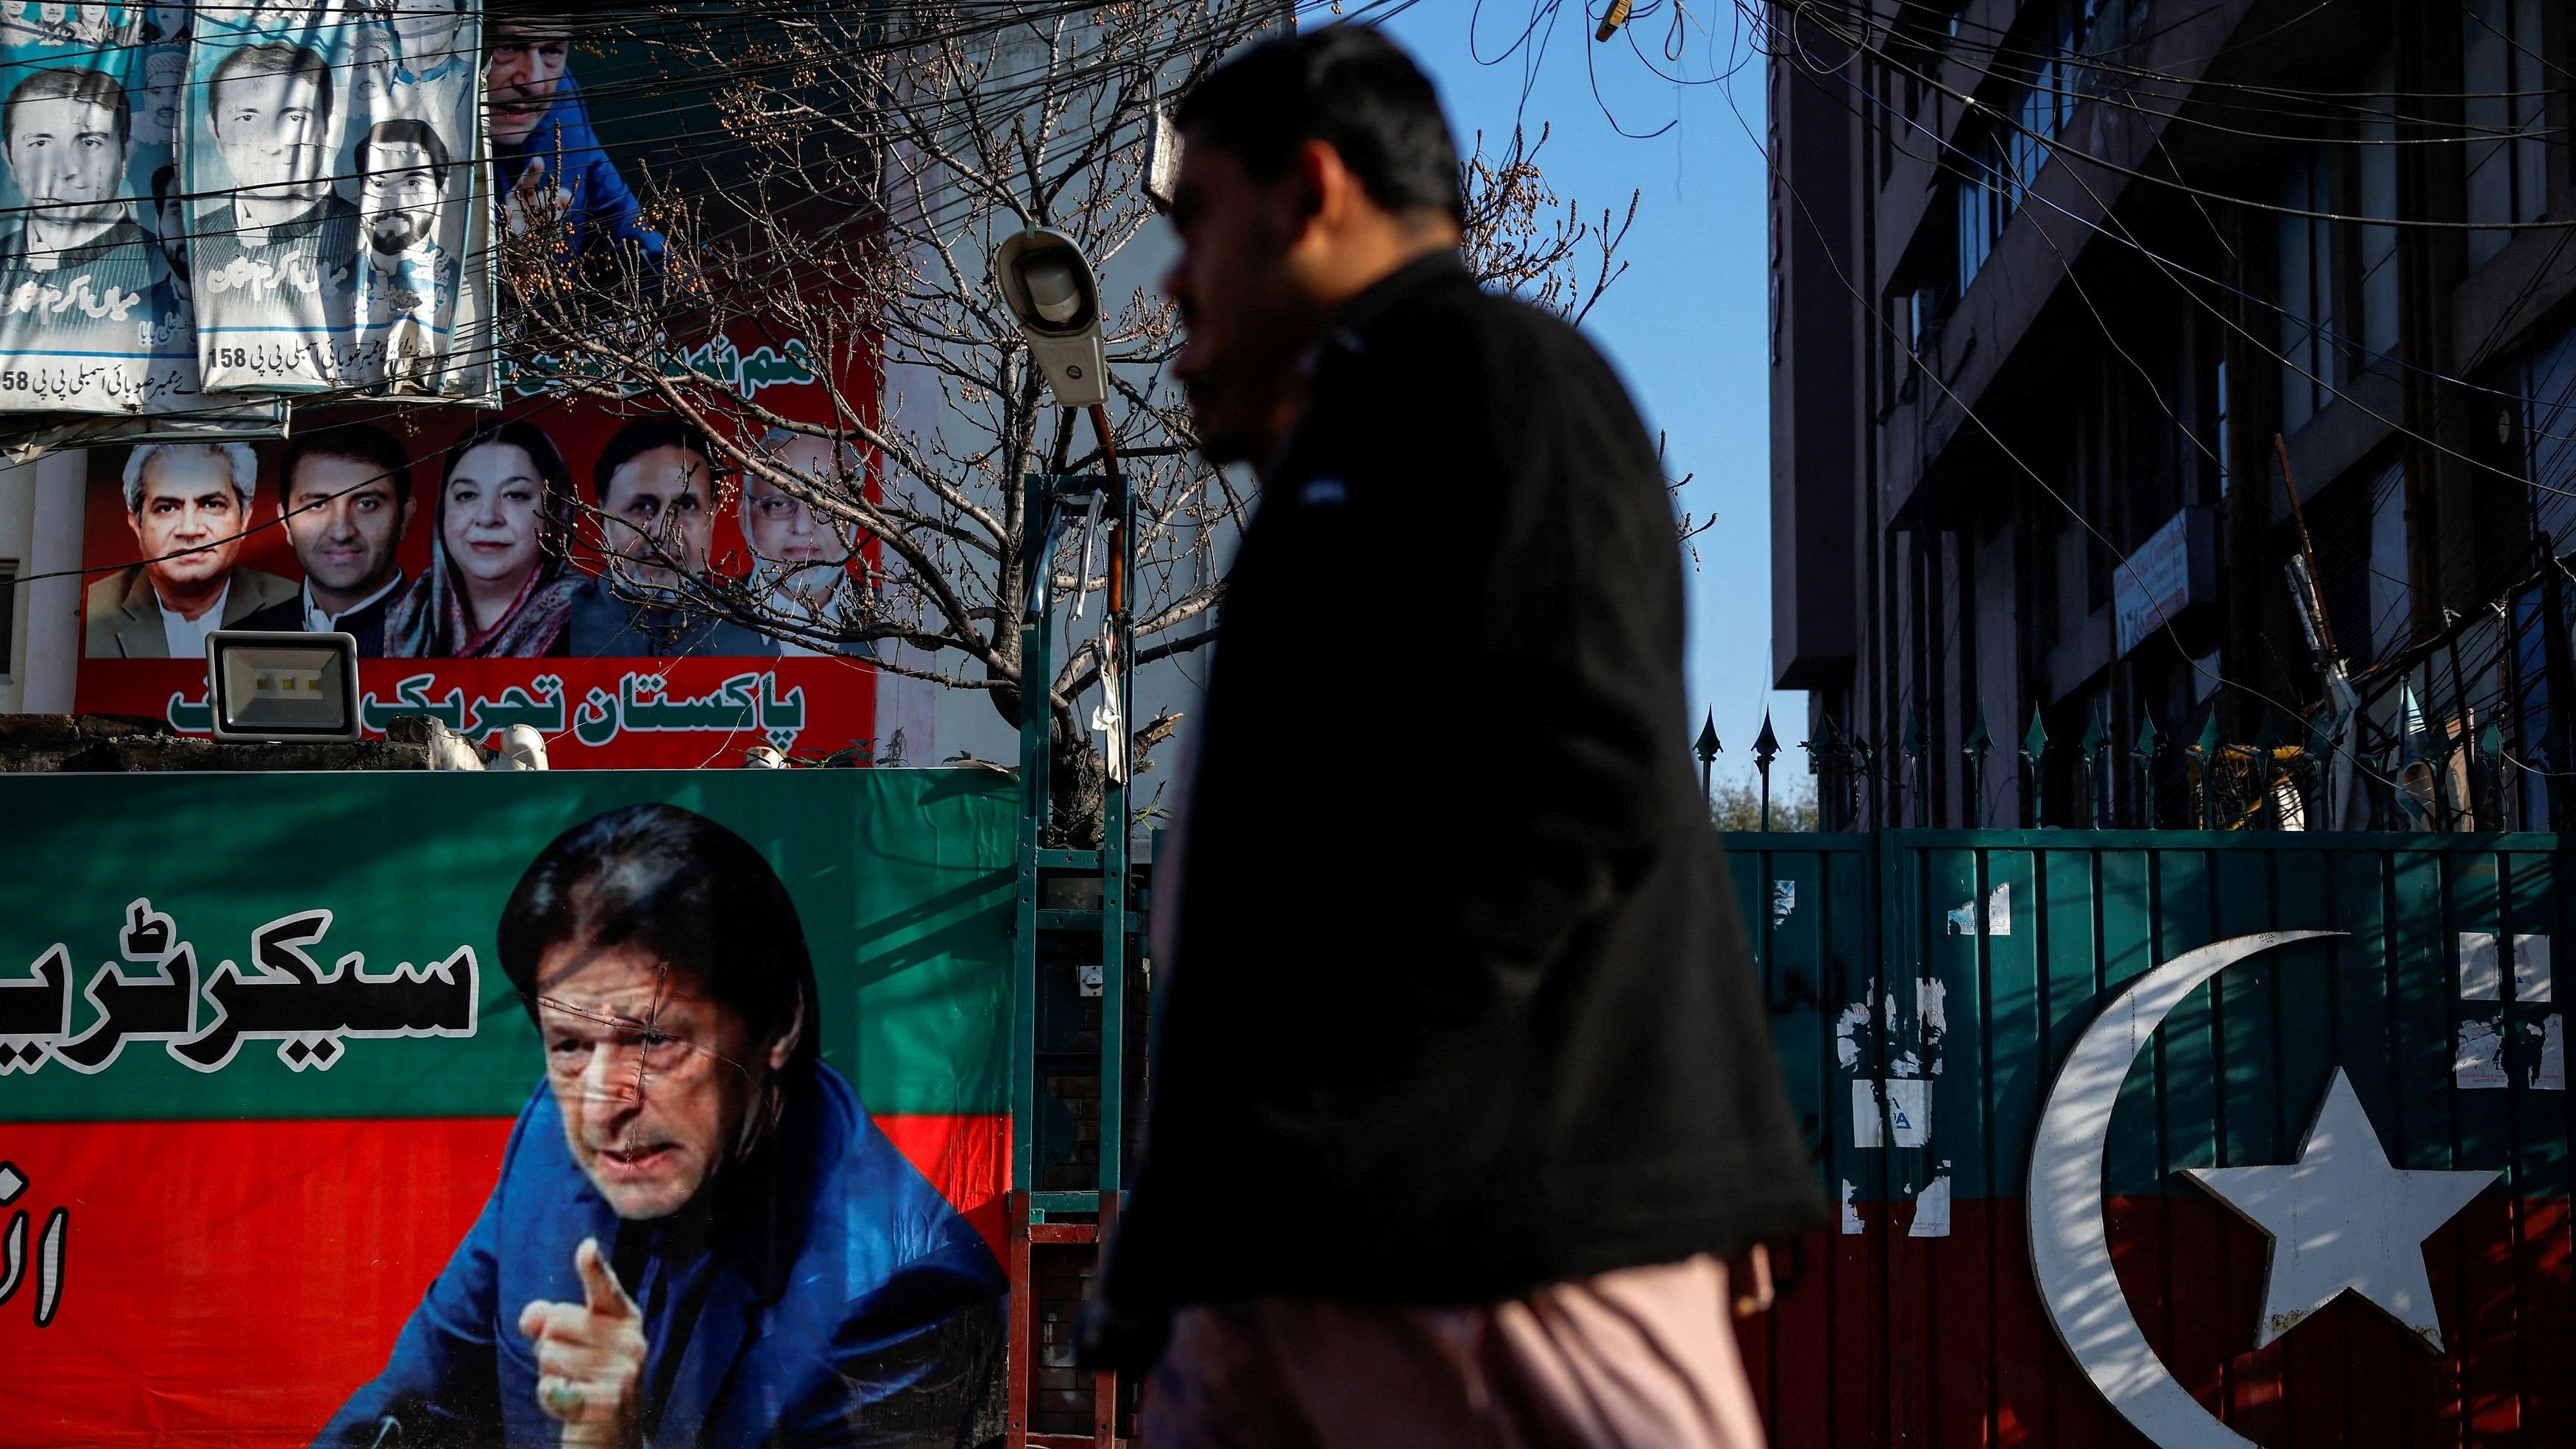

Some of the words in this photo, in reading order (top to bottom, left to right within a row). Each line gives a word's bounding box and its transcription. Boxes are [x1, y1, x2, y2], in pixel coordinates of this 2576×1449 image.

[208, 347, 246, 368] 158
[250, 344, 265, 377] پی
[268, 344, 284, 377] پی
[286, 336, 319, 370] اسمبلی
[0, 370, 29, 392] 58
[32, 368, 48, 400] پی
[51, 368, 66, 401] پی
[70, 362, 105, 395] اسمبلی
[108, 364, 155, 399] صوبائی
[361, 673, 565, 743] تحریک
[575, 671, 805, 749] پاکستان
[0, 897, 479, 1074] سیکرٹری
